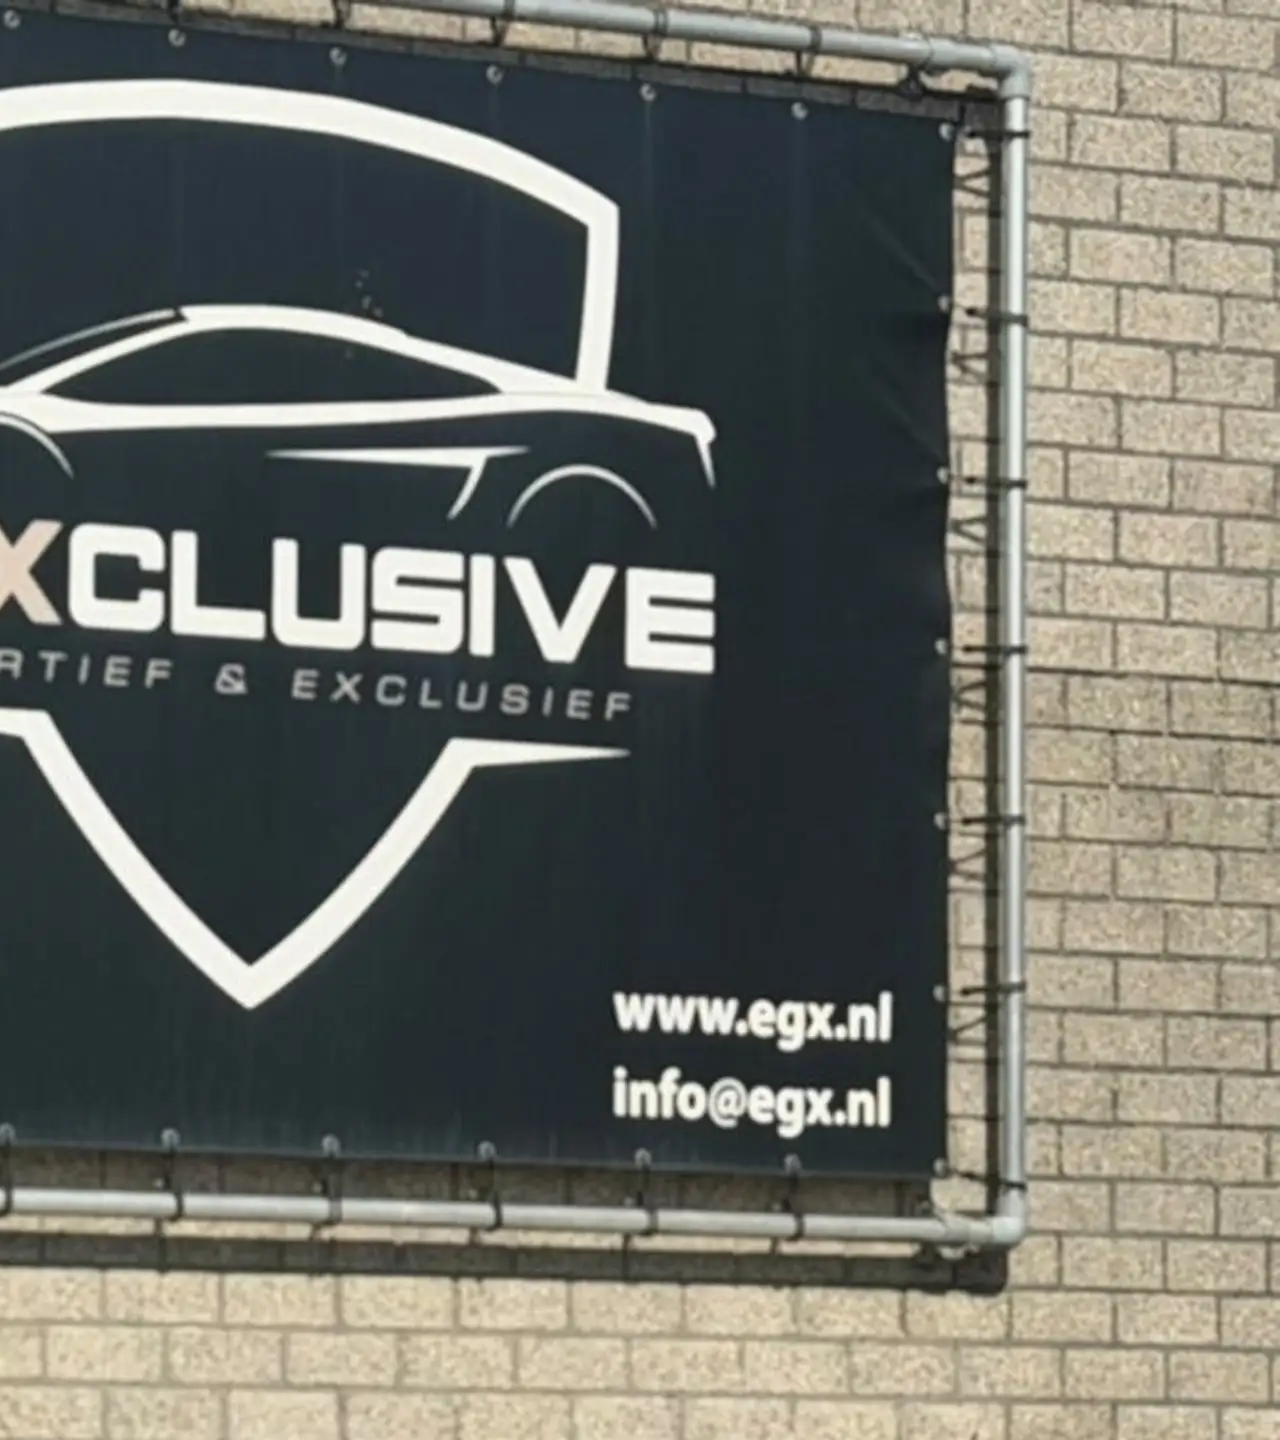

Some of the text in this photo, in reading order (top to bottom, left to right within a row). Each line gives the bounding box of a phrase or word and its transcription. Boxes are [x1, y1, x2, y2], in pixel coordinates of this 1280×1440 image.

[214, 663, 250, 695] &
[291, 667, 634, 721] EXCLUSIEF
[613, 990, 893, 1052] www.egx.nl
[613, 1065, 891, 1138] info@egx.nl
